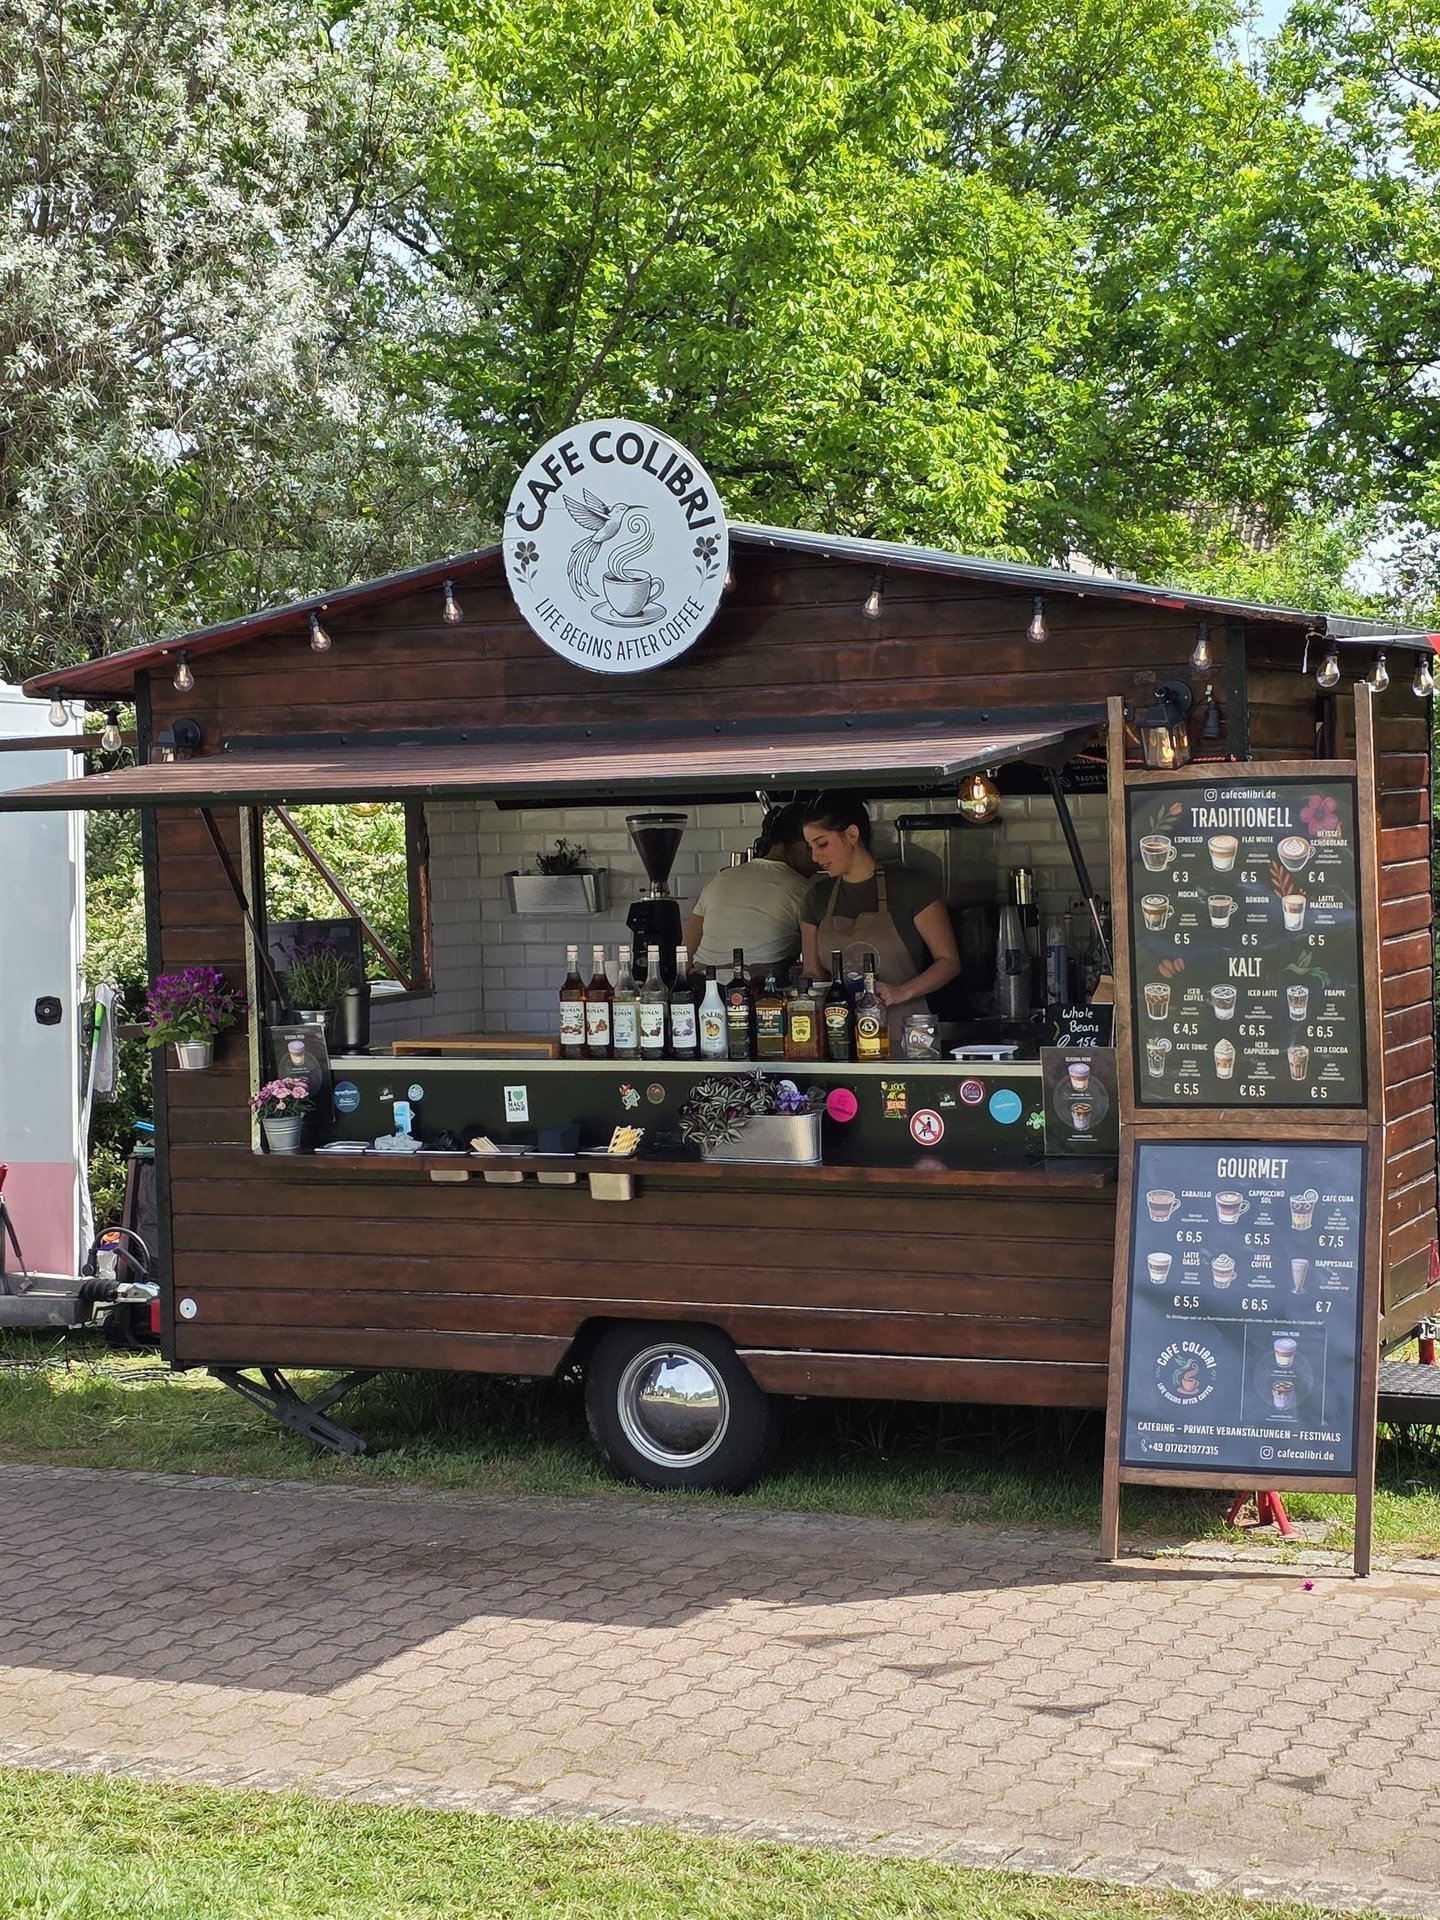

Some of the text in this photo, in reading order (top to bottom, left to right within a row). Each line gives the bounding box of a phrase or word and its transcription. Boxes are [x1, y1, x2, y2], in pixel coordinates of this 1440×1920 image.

[516, 431, 716, 531] CAFE COLIBRI
[535, 595, 705, 661] LIFE BEGINS AFTER COFFEE
[1220, 789, 1277, 800] cafecolibri.de
[1191, 807, 1292, 828] TRADITIONELL
[1174, 836, 1203, 844] ESPRESSO
[1310, 839, 1348, 847] SCHOKOLADE
[1172, 872, 1189, 883] € 3
[1241, 872, 1257, 883] € 5
[1308, 872, 1325, 883] € 4
[1174, 934, 1190, 945] € 5
[1241, 934, 1258, 946] € 5
[1308, 935, 1325, 946] € 5
[1228, 957, 1262, 978] KALT
[1184, 994, 1204, 1002] COFFEE
[1262, 990, 1278, 998] LATTE
[1062, 1006, 1093, 1019] Whole
[1069, 1020, 1099, 1033] Beans
[1173, 1023, 1198, 1035] € 4,5
[1239, 1024, 1265, 1037] € 6,5
[1307, 1026, 1333, 1038] € 6,5
[1076, 1036, 1098, 1047] 15€
[1191, 1043, 1208, 1051] TONIC
[1244, 1047, 1280, 1055] CAPPUCCINO
[1328, 1046, 1348, 1054] COCOA
[1174, 1083, 1199, 1096] € 5,5
[1239, 1085, 1266, 1097] € 6,5
[1311, 1087, 1327, 1098] € 5
[508, 1091, 512, 1101] I
[1217, 1158, 1288, 1179] GOURMET
[1181, 1190, 1212, 1198] CARAJILLO
[1248, 1189, 1285, 1198] CAPPUCCINO
[1176, 1231, 1202, 1243] € 6,5
[1244, 1233, 1270, 1246] € 5,5
[1318, 1235, 1344, 1248] € 7,5
[1182, 1258, 1200, 1266] OASIS
[1254, 1254, 1271, 1262] IRISH
[1251, 1261, 1272, 1269] COFFEE
[1315, 1260, 1354, 1269] HAPPYSHAKE
[1173, 1296, 1199, 1308] € 5,5
[1241, 1298, 1268, 1311] € 6,5
[1315, 1301, 1332, 1313] € 7
[1157, 1341, 1217, 1368] CAFE COLIBRI
[1157, 1382, 1214, 1405] LIFE BEGINS AFTER COFFEE
[1137, 1422, 1175, 1433] CATERING
[1183, 1424, 1215, 1435] PRIVATE
[1216, 1426, 1291, 1439] VERANSTALTUNGEN
[1300, 1431, 1341, 1442] FESTIVALS
[1148, 1442, 1219, 1455] +49 017621977315
[1277, 1449, 1335, 1461] cafecolibri.de
